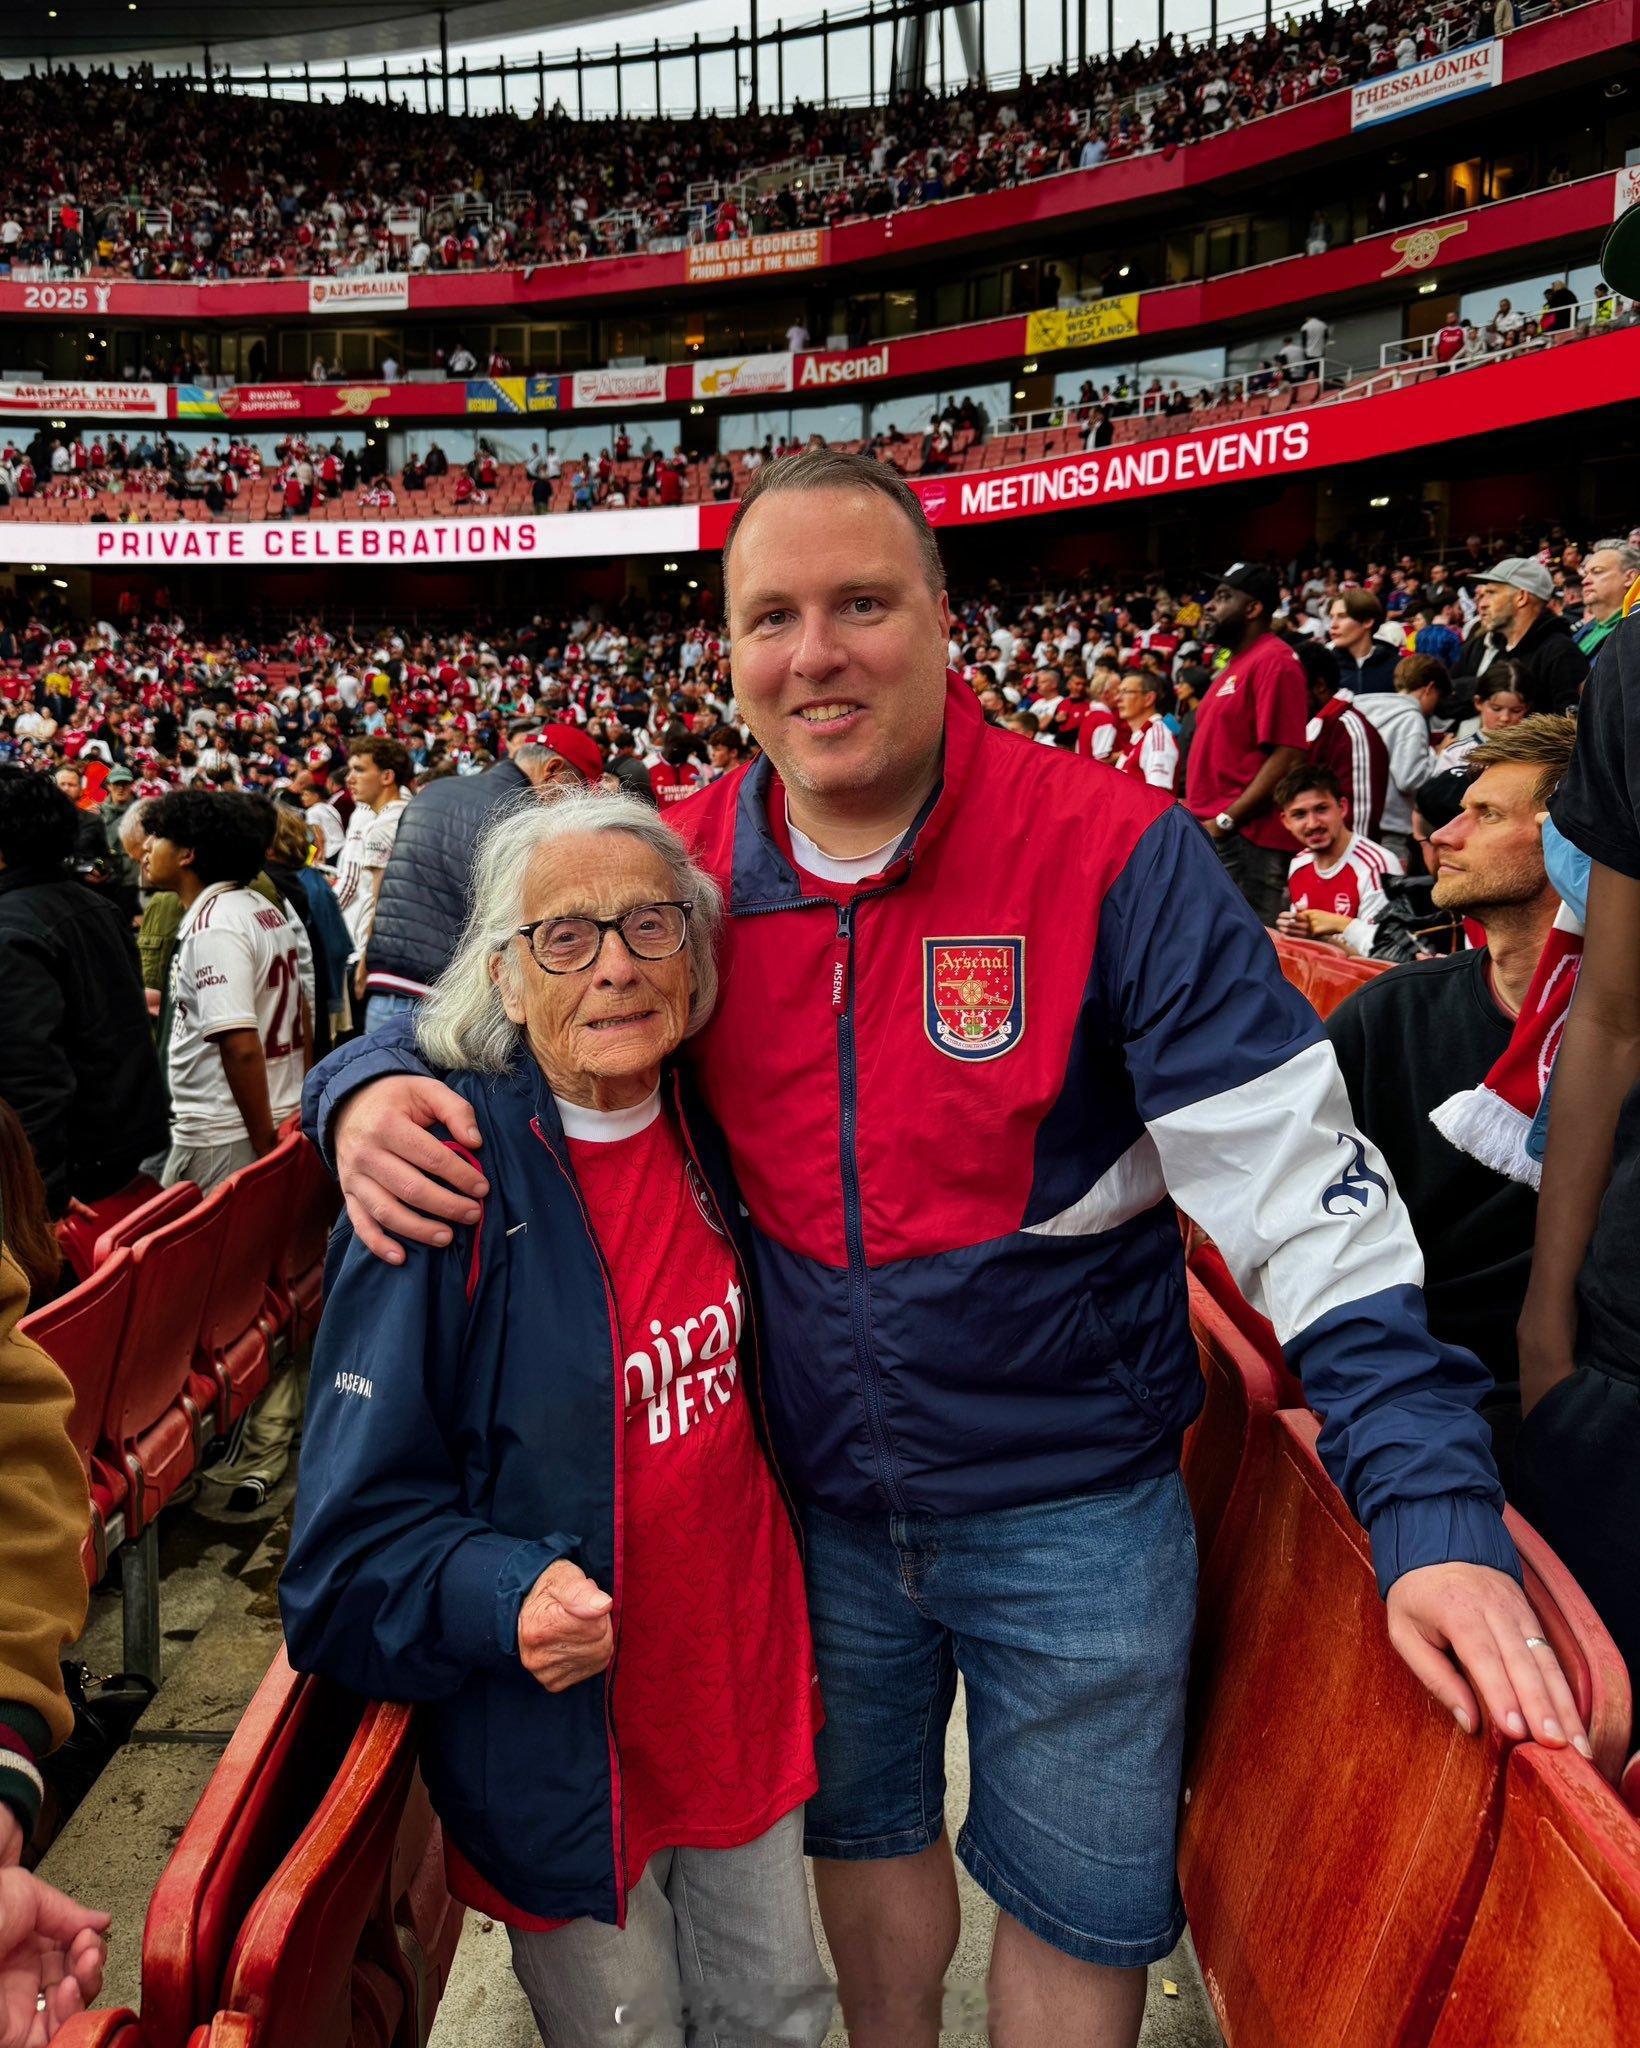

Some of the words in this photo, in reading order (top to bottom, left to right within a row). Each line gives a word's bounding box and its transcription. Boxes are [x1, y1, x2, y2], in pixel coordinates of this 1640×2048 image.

[690, 239, 750, 264] ATHLONE
[751, 231, 818, 256] GOONERS
[690, 262, 725, 281] PROUD
[726, 259, 740, 276] TO
[741, 257, 762, 273] SAY
[763, 253, 784, 271] THE
[785, 250, 818, 268] NAME
[25, 286, 88, 309] 2025
[1066, 316, 1101, 332] WEST
[1067, 321, 1134, 345] MIDLANDS
[800, 346, 889, 386] Arsenal
[16, 386, 88, 399] ARSENAL
[95, 387, 151, 399] KENYA
[241, 398, 301, 412] SUPPORTERS
[248, 390, 292, 401] RWANDA
[960, 461, 1099, 516] MEETINGS
[1103, 446, 1169, 493] AND
[1174, 422, 1309, 481] EVENTS
[98, 532, 244, 558] PRIVATE
[265, 524, 537, 557] CELEBRATIONS
[937, 948, 1009, 971] Arsenal
[832, 961, 843, 1006] ARSENAL
[334, 1371, 373, 1398] ARSENAL
